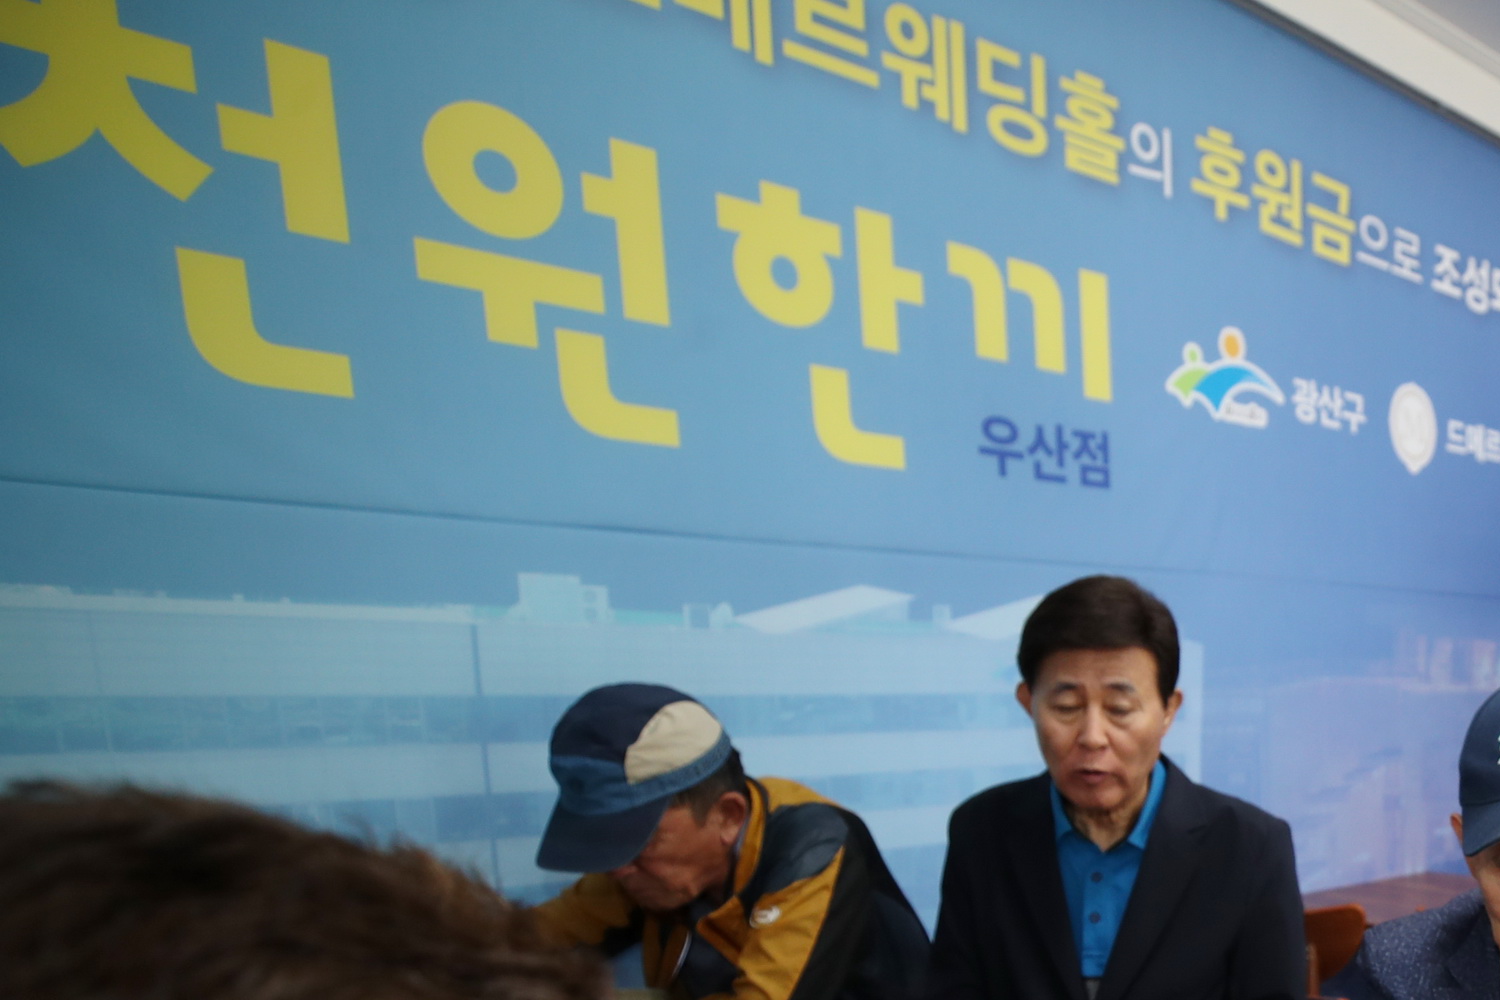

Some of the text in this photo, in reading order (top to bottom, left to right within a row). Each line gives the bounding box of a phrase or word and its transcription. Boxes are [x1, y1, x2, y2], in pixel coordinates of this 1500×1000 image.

[620, 0, 1173, 198] 르웨딩홀의
[1191, 126, 1424, 285] 후원금으로
[1291, 377, 1368, 435] 광산구
[977, 415, 1112, 489] 우산점
